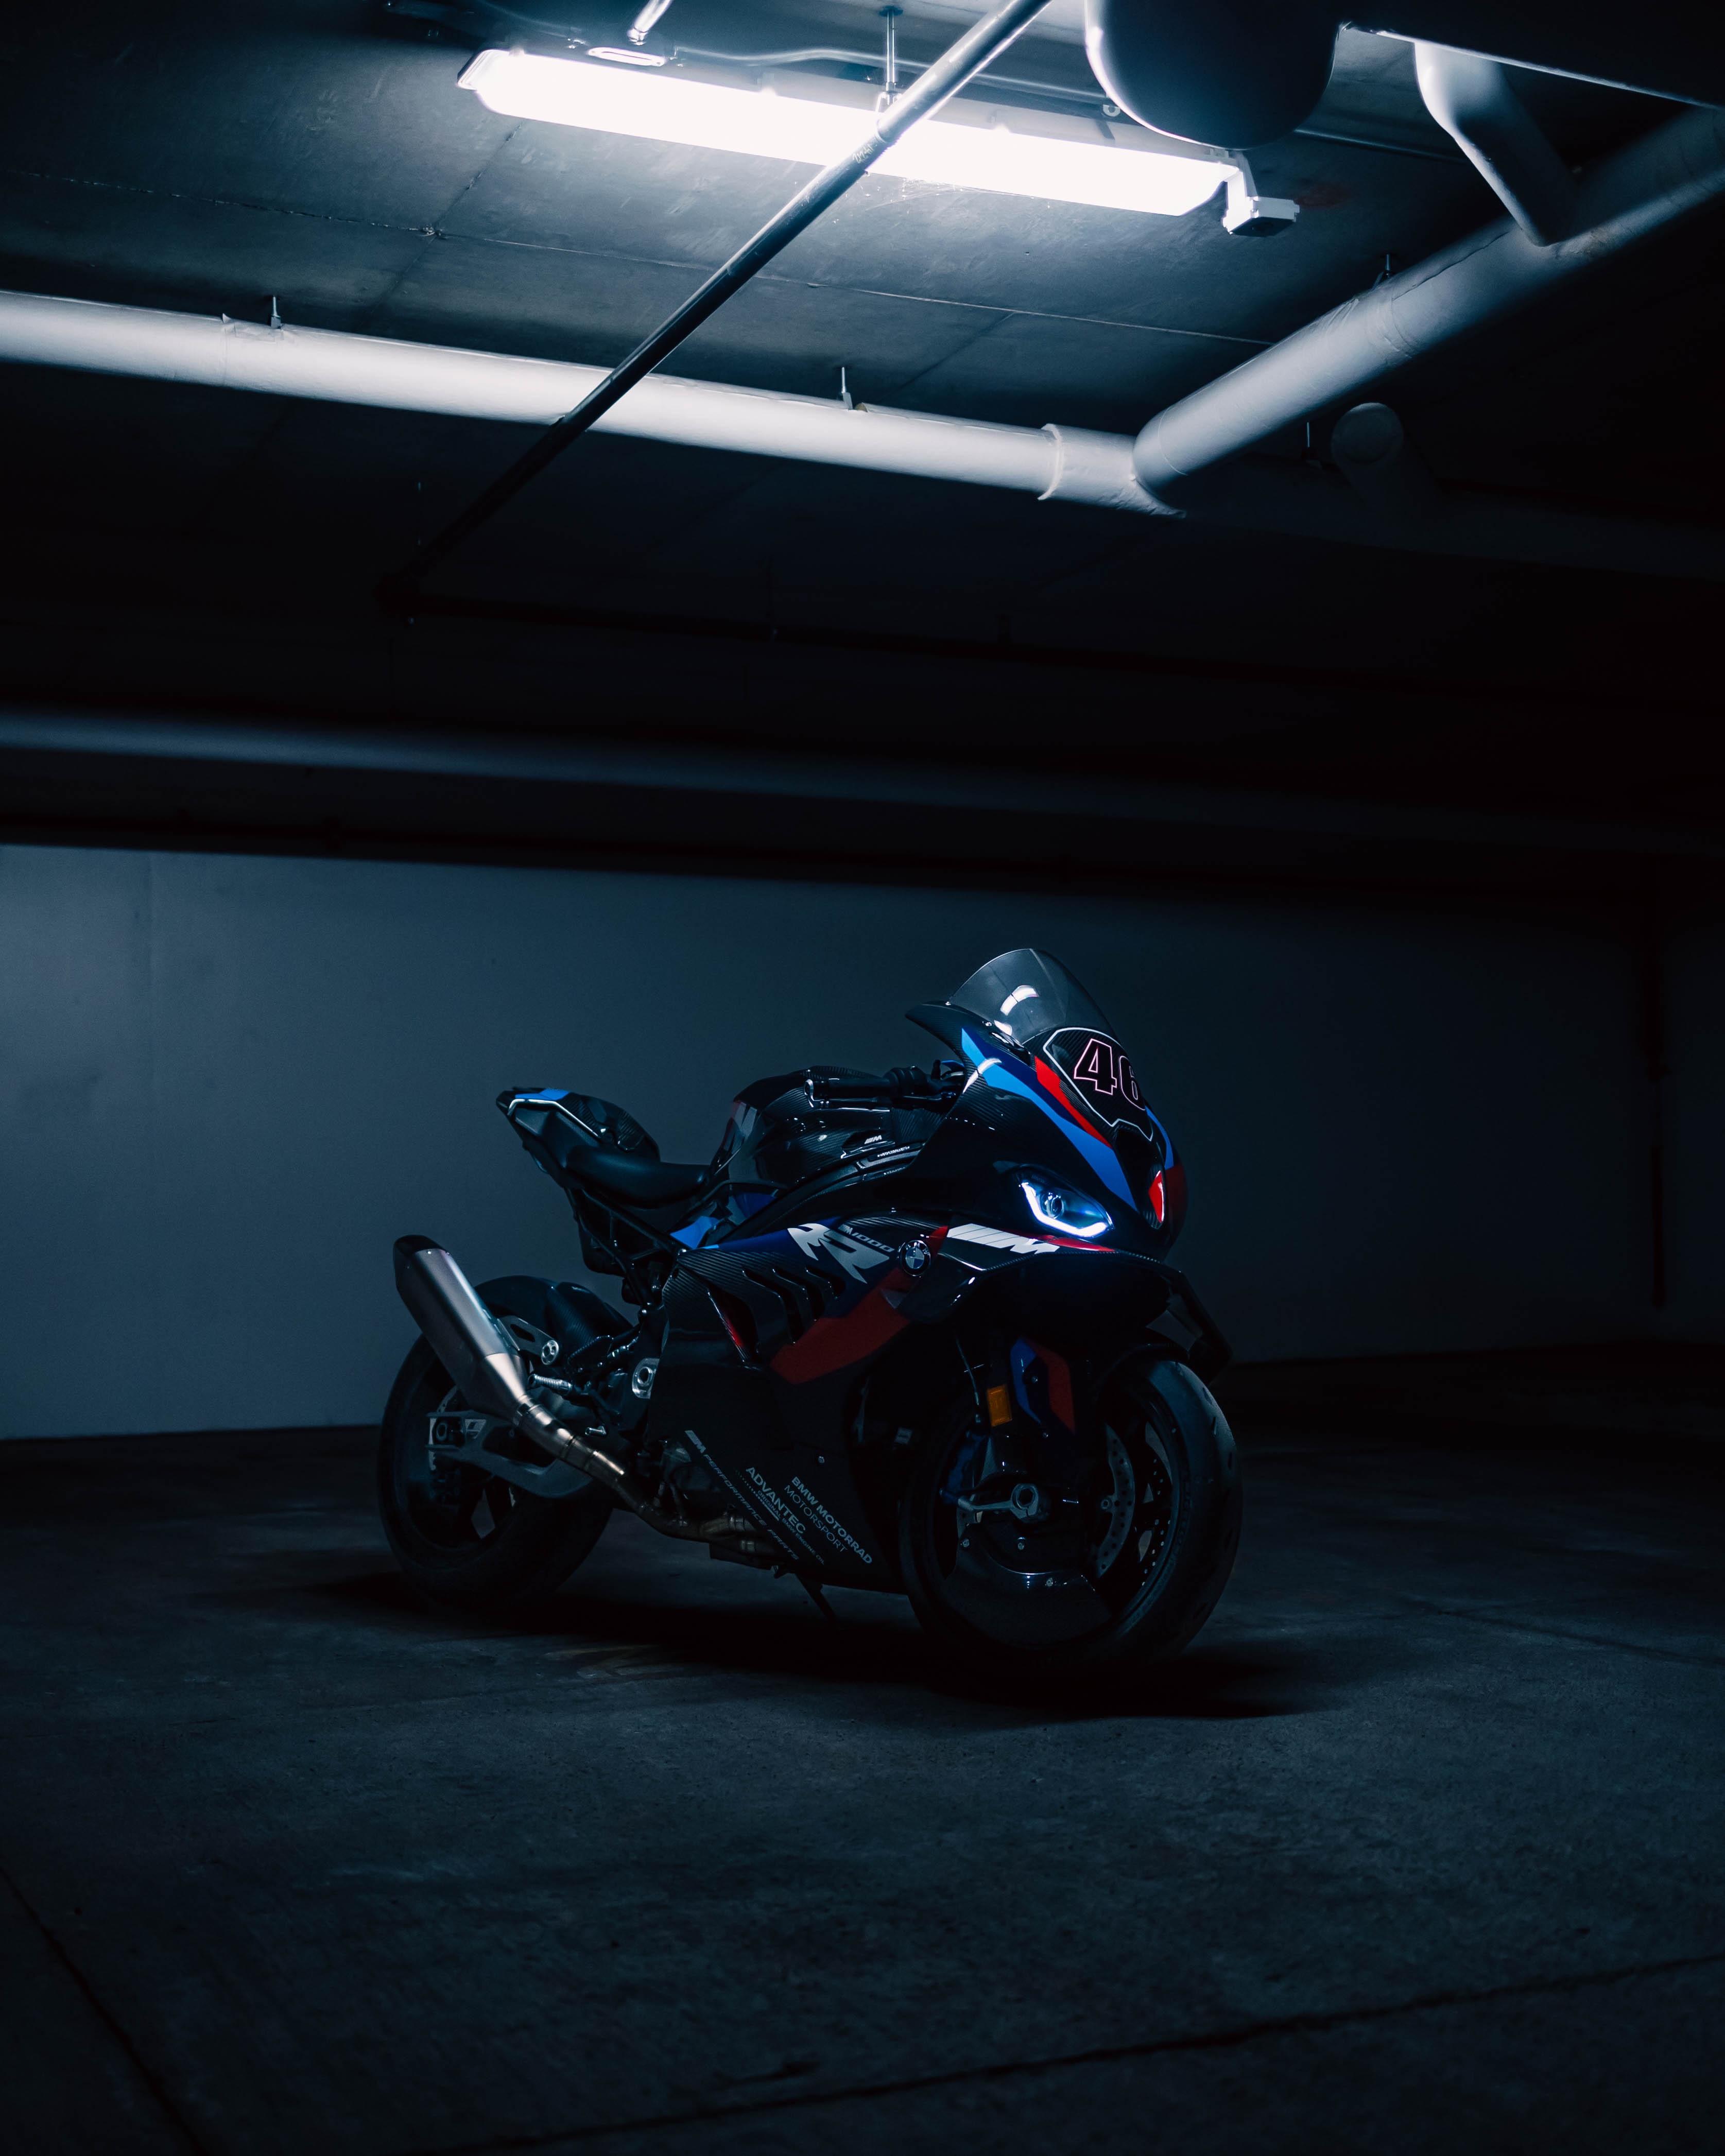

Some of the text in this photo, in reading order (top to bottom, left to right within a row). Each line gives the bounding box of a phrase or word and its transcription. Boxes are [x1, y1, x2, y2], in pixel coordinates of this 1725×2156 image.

[703, 1454, 768, 1527] PERFORMANCE
[767, 1529, 799, 1561] PARTS
[746, 1467, 806, 1534] ADVANTEC
[757, 1490, 781, 1517] ORIGINAL
[784, 1485, 849, 1553] MOTORSPORT
[791, 1476, 873, 1564] BMW MOTORRAD
